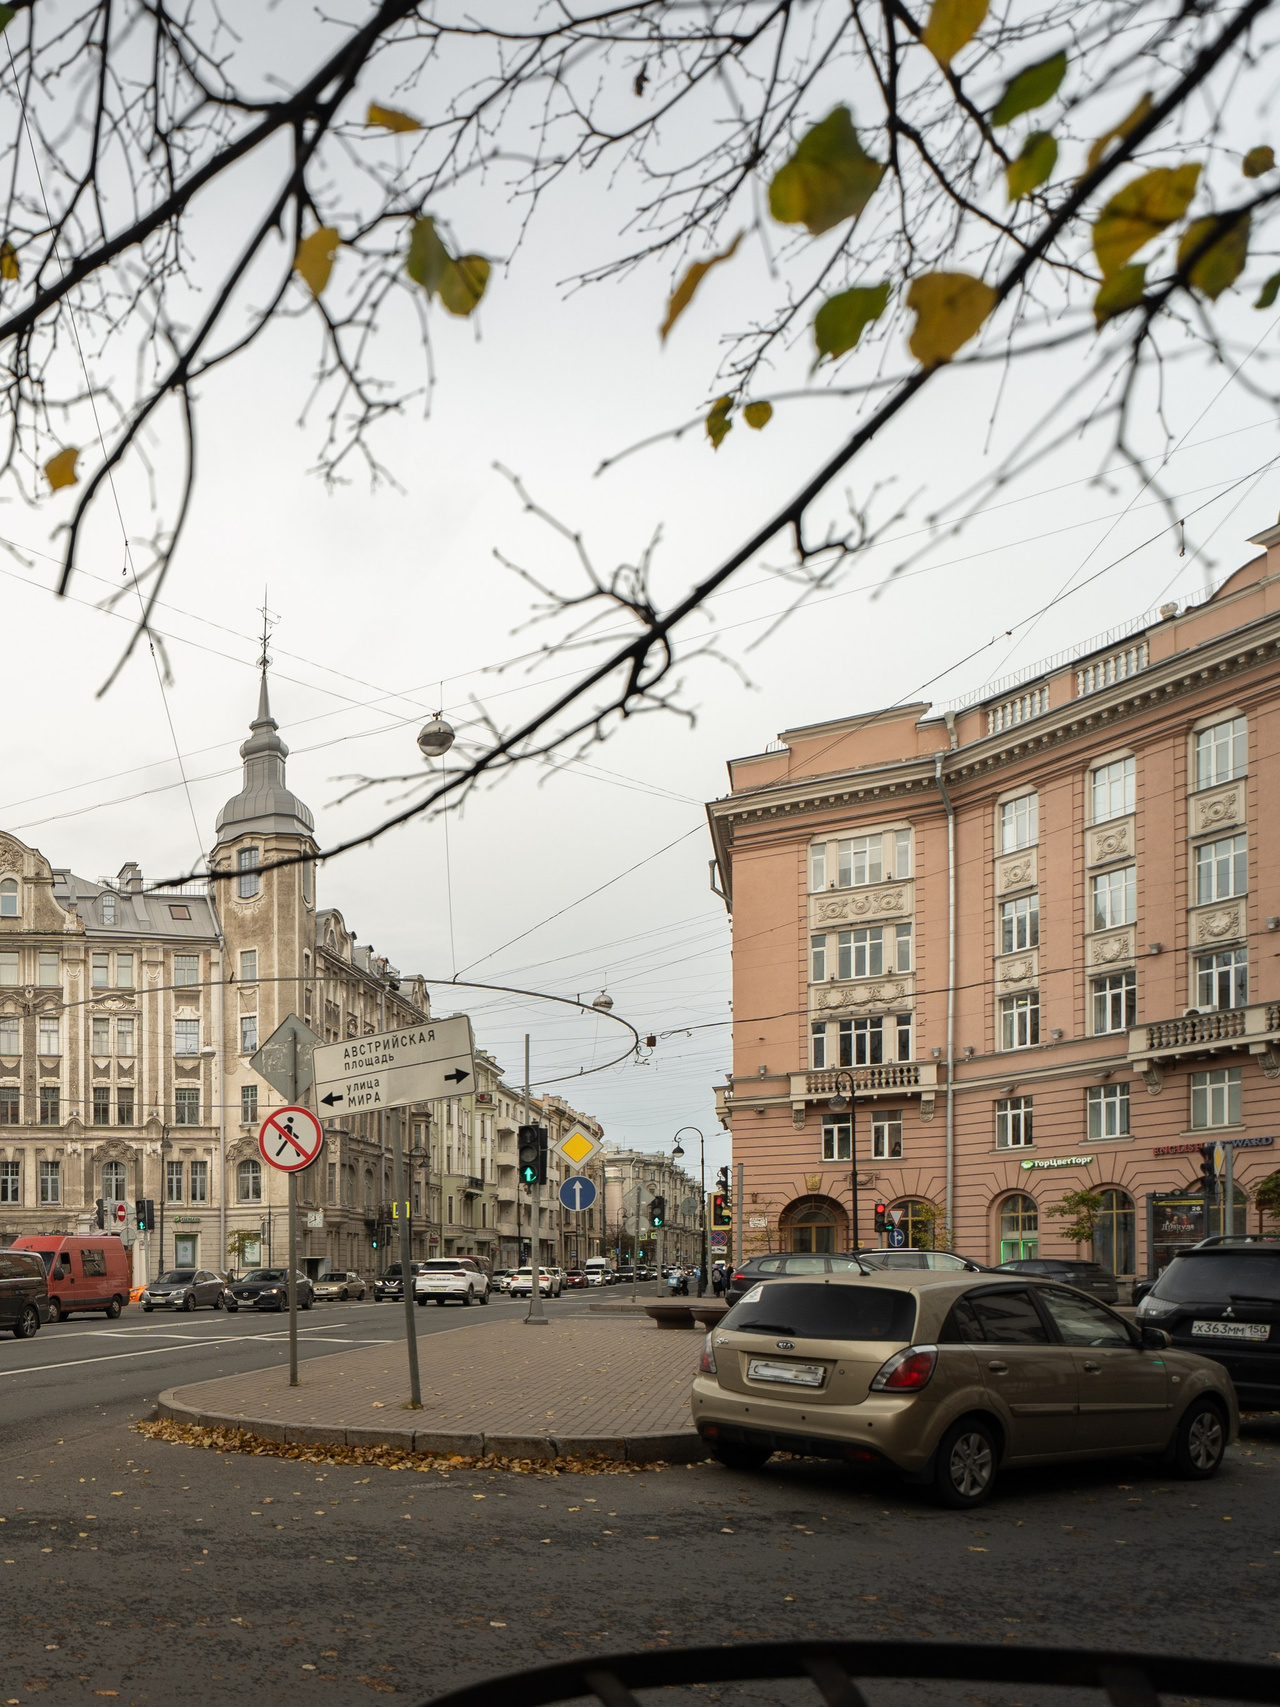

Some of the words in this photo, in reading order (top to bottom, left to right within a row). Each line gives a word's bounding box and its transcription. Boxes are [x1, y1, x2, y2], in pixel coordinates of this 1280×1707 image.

[343, 1029, 436, 1059] АВСТРИЙСКАЯ
[344, 1053, 395, 1071] площадь
[346, 1078, 380, 1096] улица
[348, 1092, 381, 1108] МИРА
[1153, 1143, 1205, 1156] ENGLISH
[1034, 1157, 1092, 1168] ГорЦветТорг
